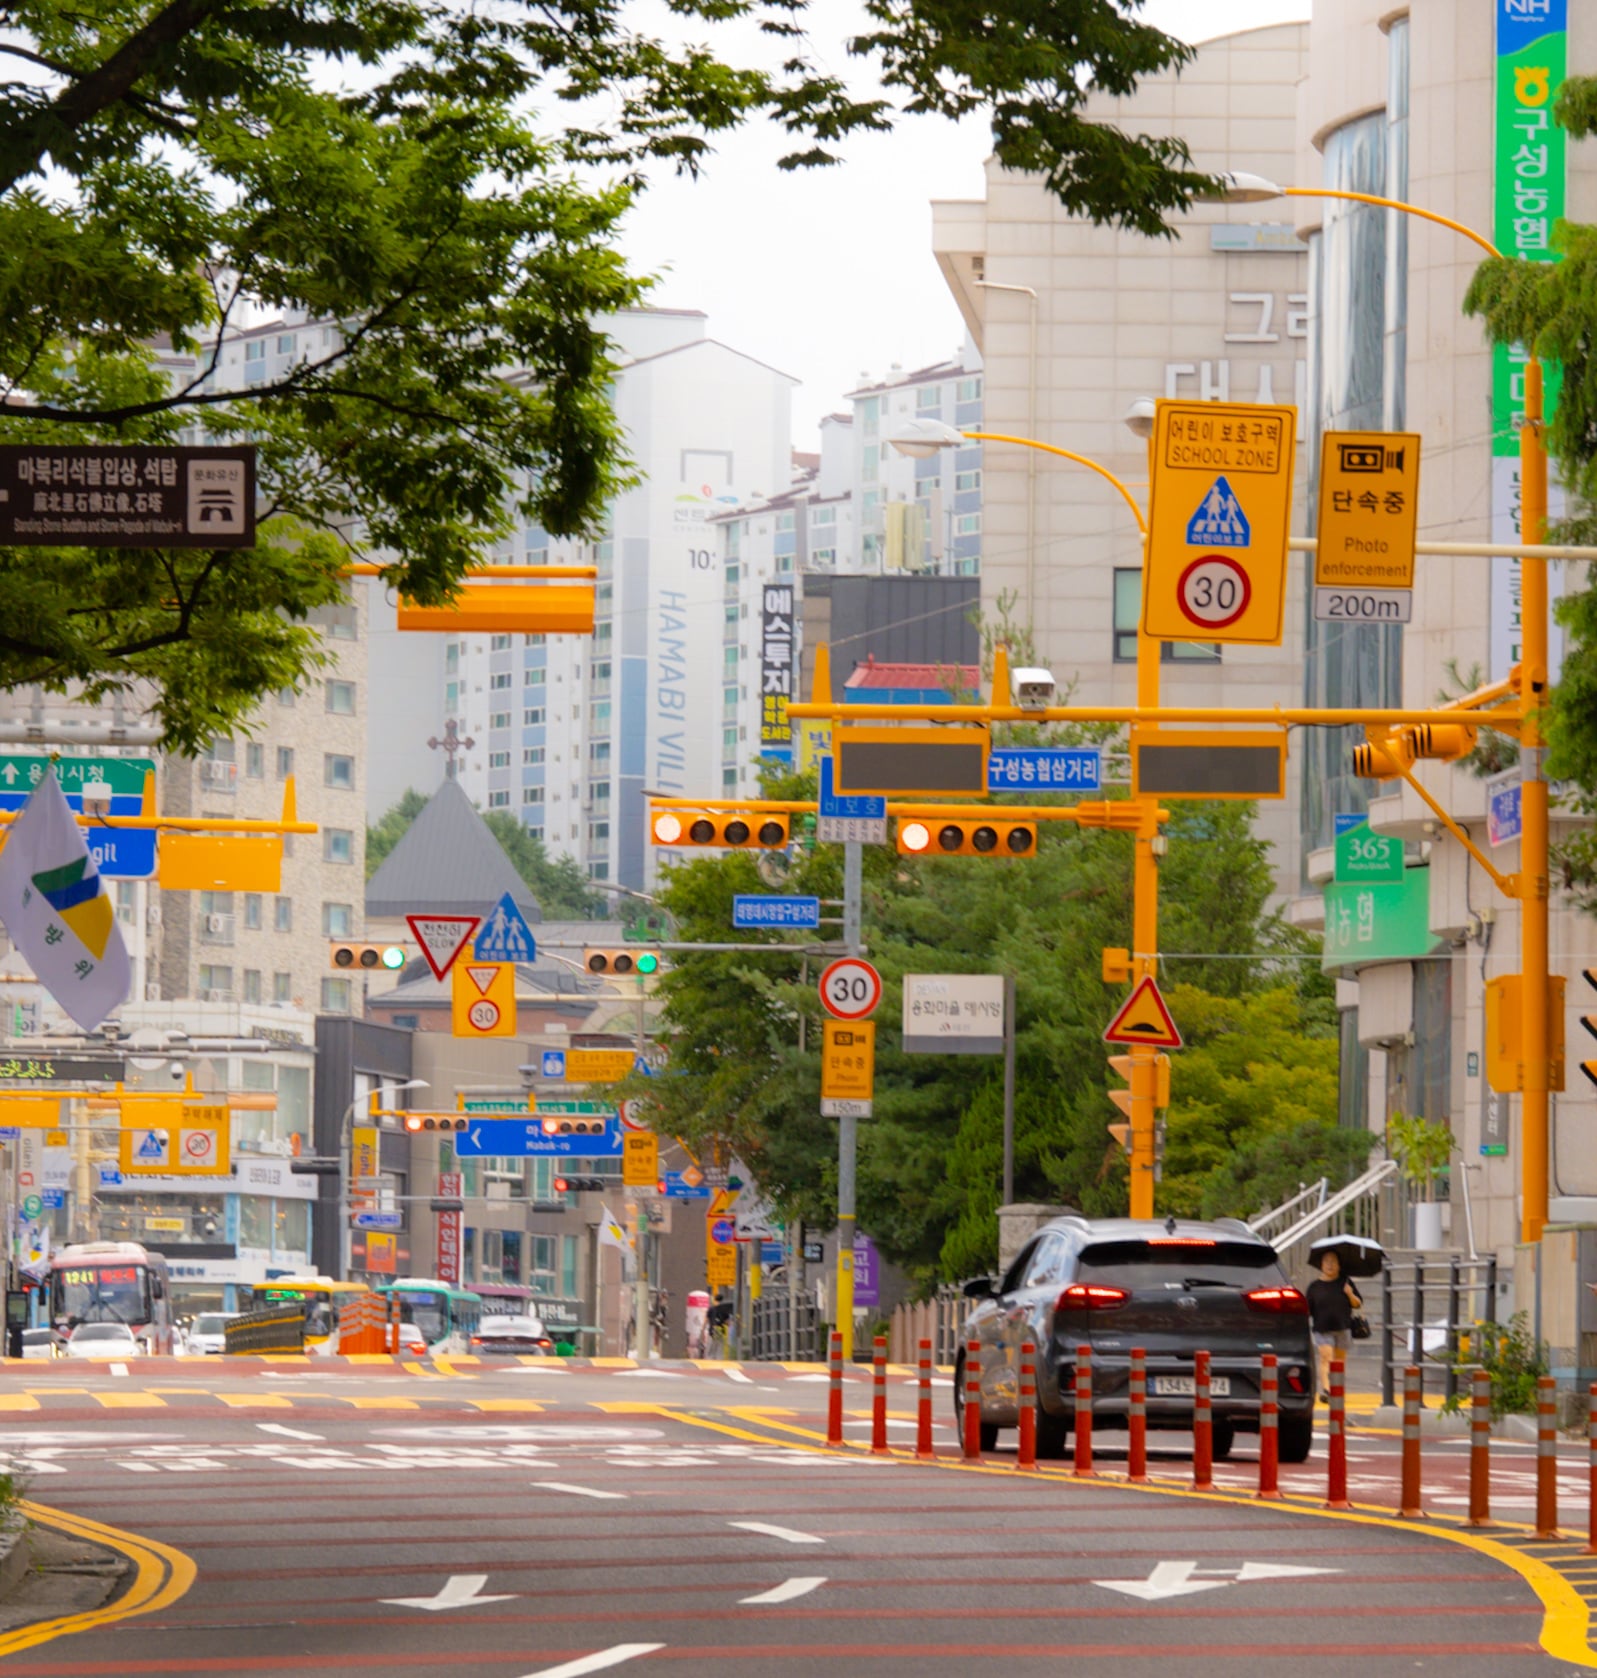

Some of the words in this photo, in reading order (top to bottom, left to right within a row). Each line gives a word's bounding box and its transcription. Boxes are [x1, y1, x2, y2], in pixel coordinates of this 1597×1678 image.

[1505, 0, 1549, 13] NH
[1510, 108, 1549, 250] 구성농협
[1172, 419, 1213, 441] 어린이
[1221, 423, 1278, 445] 보호구역
[1172, 446, 1230, 465] SCHOOL
[1235, 449, 1275, 467] ZONE
[144, 457, 178, 486] 석탑
[194, 469, 238, 482] 문화유산
[1333, 489, 1405, 514] 단속중
[1344, 537, 1389, 553] Photo
[1323, 562, 1408, 577] enforcement
[1194, 577, 1236, 609] 30
[1328, 595, 1399, 617] 200m
[763, 589, 791, 694] 에스투지
[656, 589, 687, 721] HAMABI
[990, 757, 1097, 782] 구성농협삼거리
[1348, 838, 1390, 861] 365
[834, 977, 867, 1002] 30
[474, 1008, 494, 1022] 30
[832, 1101, 862, 1113] 150m
